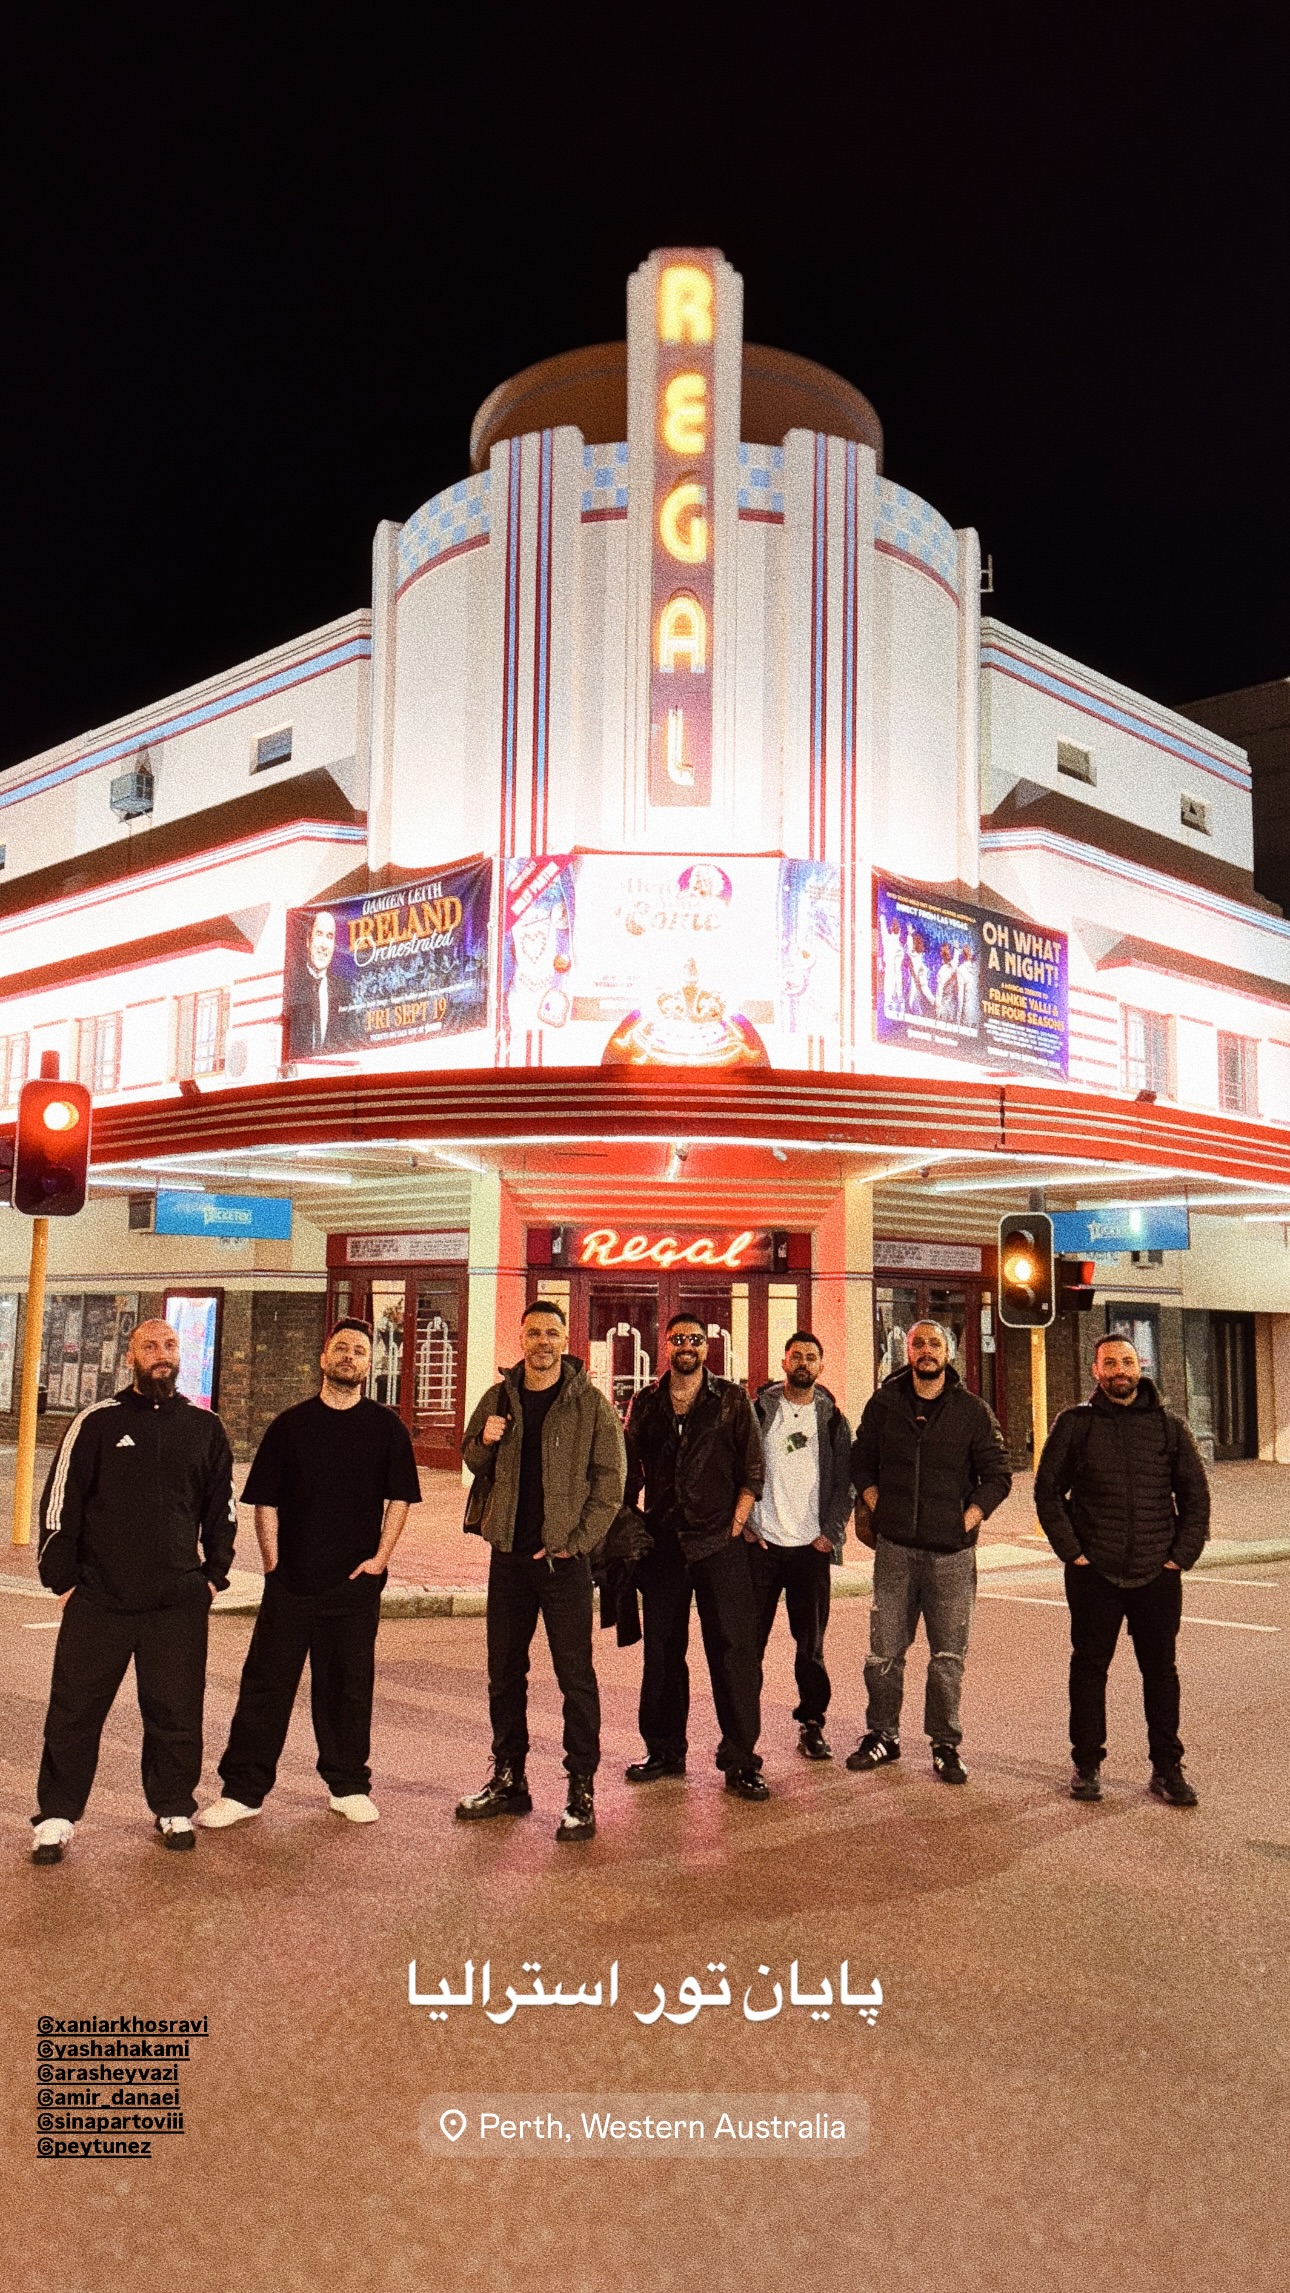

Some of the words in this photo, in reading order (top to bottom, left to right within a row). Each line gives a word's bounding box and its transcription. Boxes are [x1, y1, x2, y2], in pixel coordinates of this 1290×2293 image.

[656, 265, 715, 787] REGAL
[362, 891, 406, 915] DAMIEN
[408, 881, 443, 904] LEITH
[347, 895, 463, 952] IRELAND
[354, 925, 454, 967] Orchestrated
[982, 921, 1009, 949] OH
[1013, 929, 1062, 964] WHAT
[988, 947, 1001, 972] A
[1004, 951, 1059, 988] NIGHT!
[365, 1007, 391, 1032] FRI
[394, 1000, 428, 1027] SEPT
[433, 996, 447, 1021] 19
[982, 1000, 1000, 1015] THE
[1001, 1005, 1026, 1023] FOUR
[1027, 1011, 1065, 1031] SEASONS
[988, 987, 1027, 1009] FRANKIE
[1028, 998, 1051, 1015] VALLI
[580, 1229, 755, 1268] Regal
[617, 1322, 631, 1337] R
[707, 1323, 721, 1338] R
